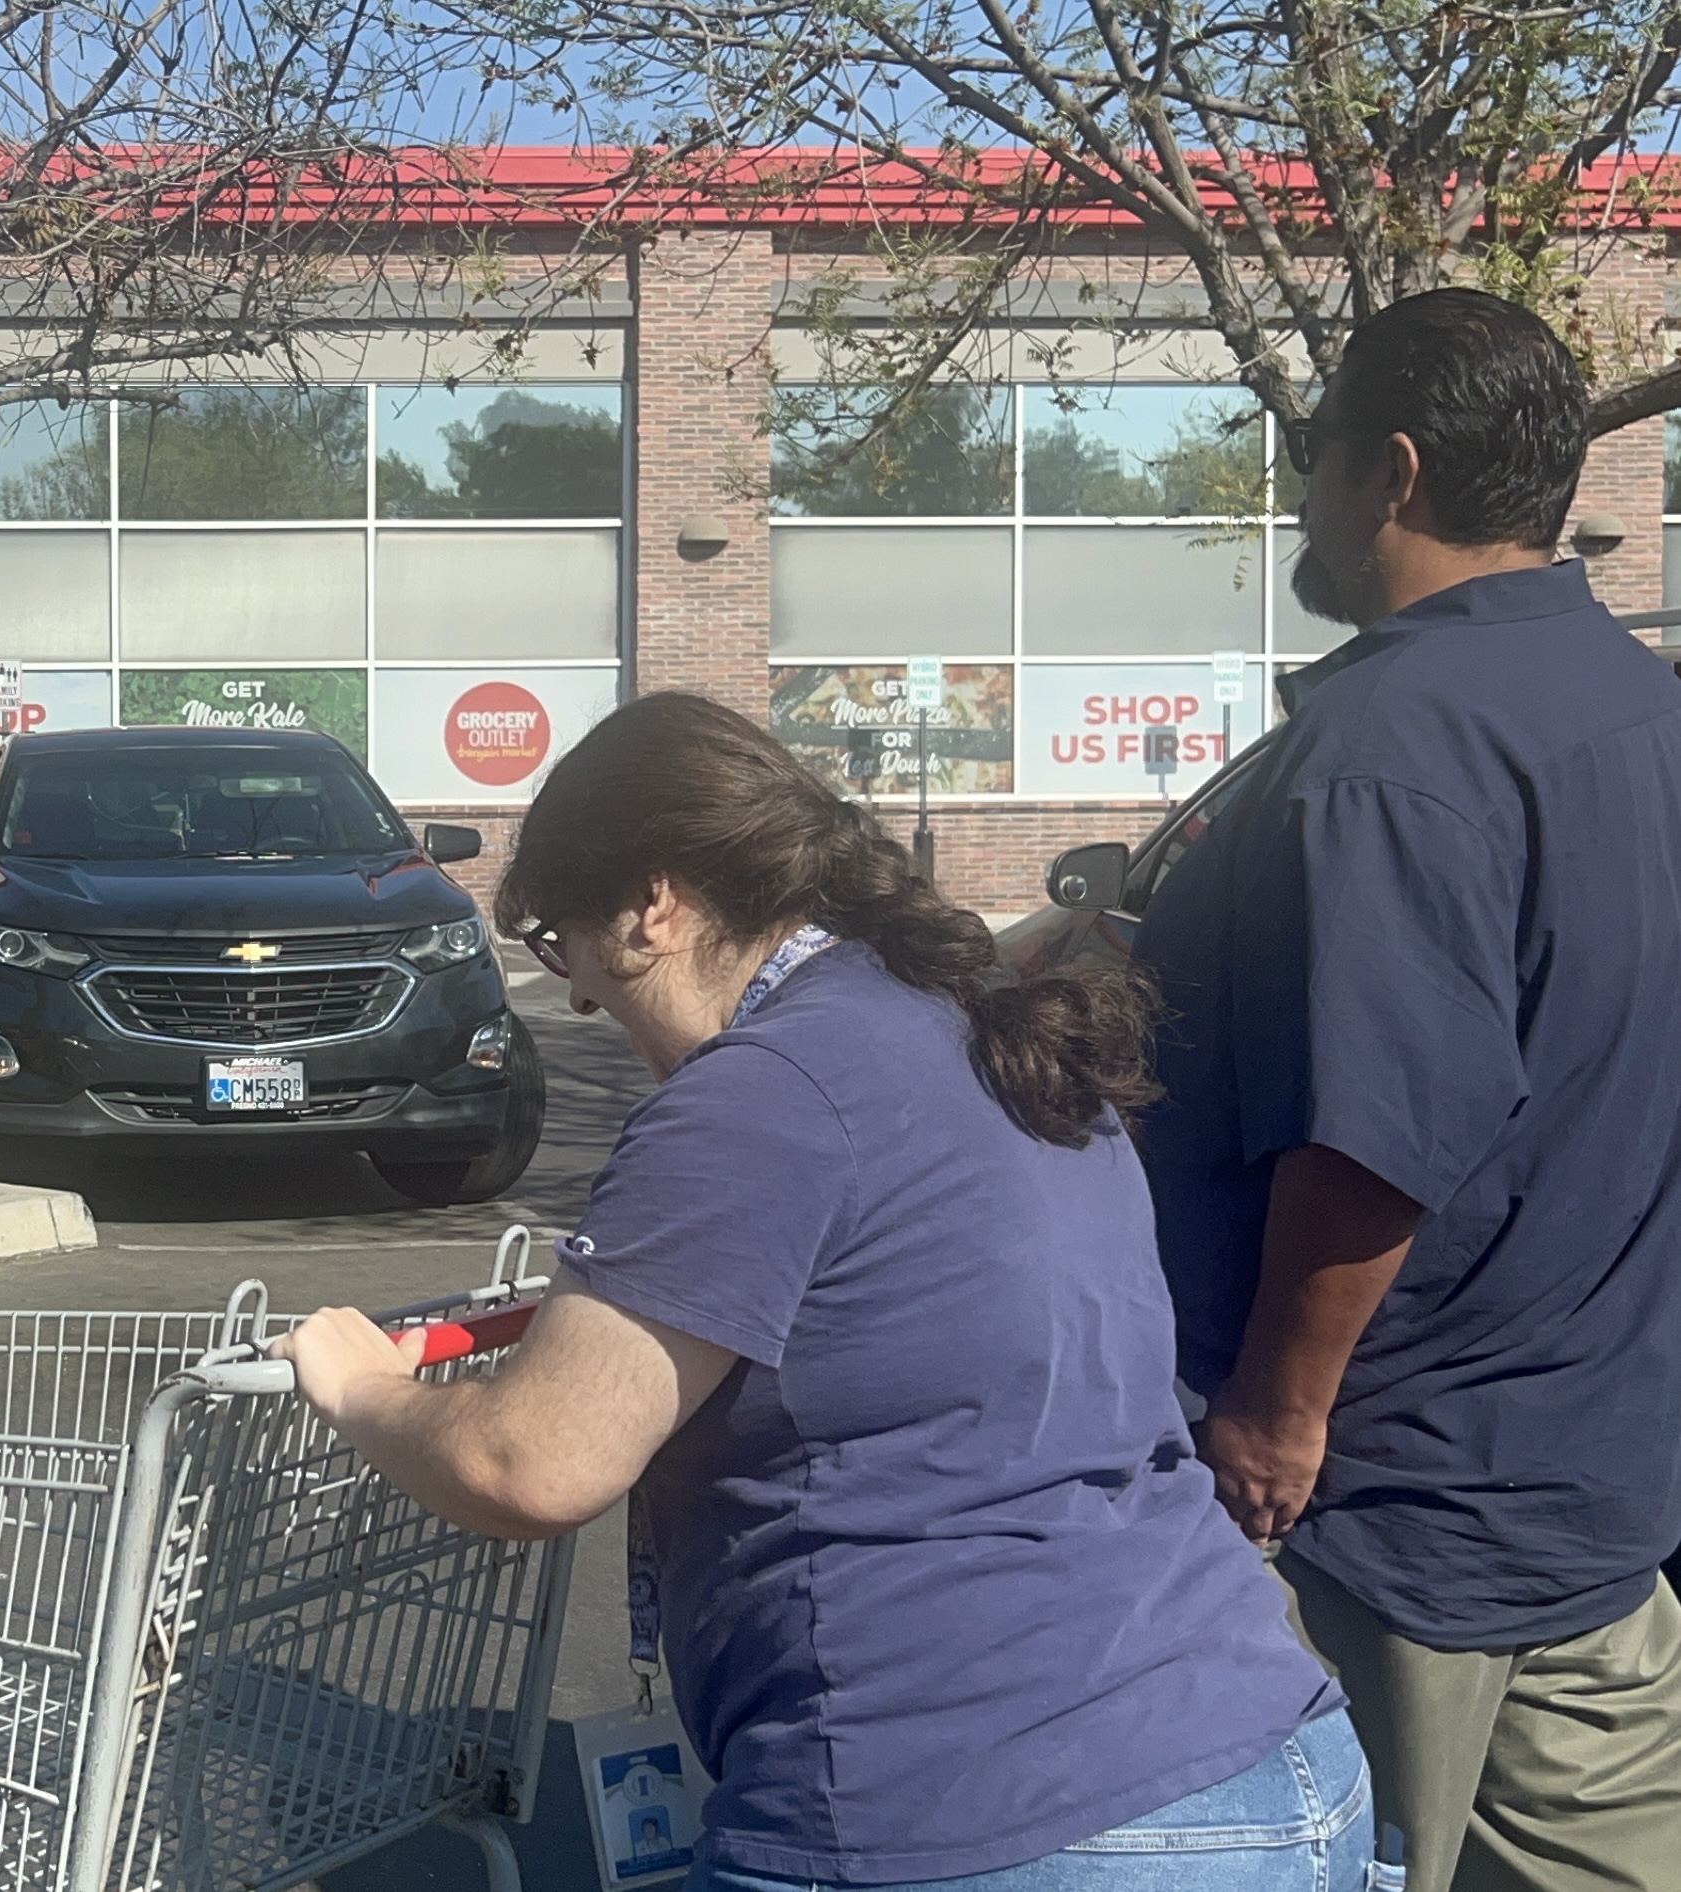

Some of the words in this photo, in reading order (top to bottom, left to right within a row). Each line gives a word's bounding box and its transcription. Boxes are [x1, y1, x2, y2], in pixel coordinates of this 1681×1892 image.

[222, 681, 265, 698] GET
[181, 700, 246, 727] More
[247, 701, 306, 728] Kale
[457, 711, 537, 729] GROCERY
[830, 698, 889, 728] More
[1083, 695, 1199, 724] SHOP
[468, 729, 526, 747] OUTLET
[870, 731, 912, 748] FOR
[1051, 734, 1105, 763] US
[1117, 733, 1225, 763] FIRST
[880, 750, 942, 776] Douh
[231, 1057, 283, 1067] MICHAEL
[230, 1078, 292, 1103] CM558
